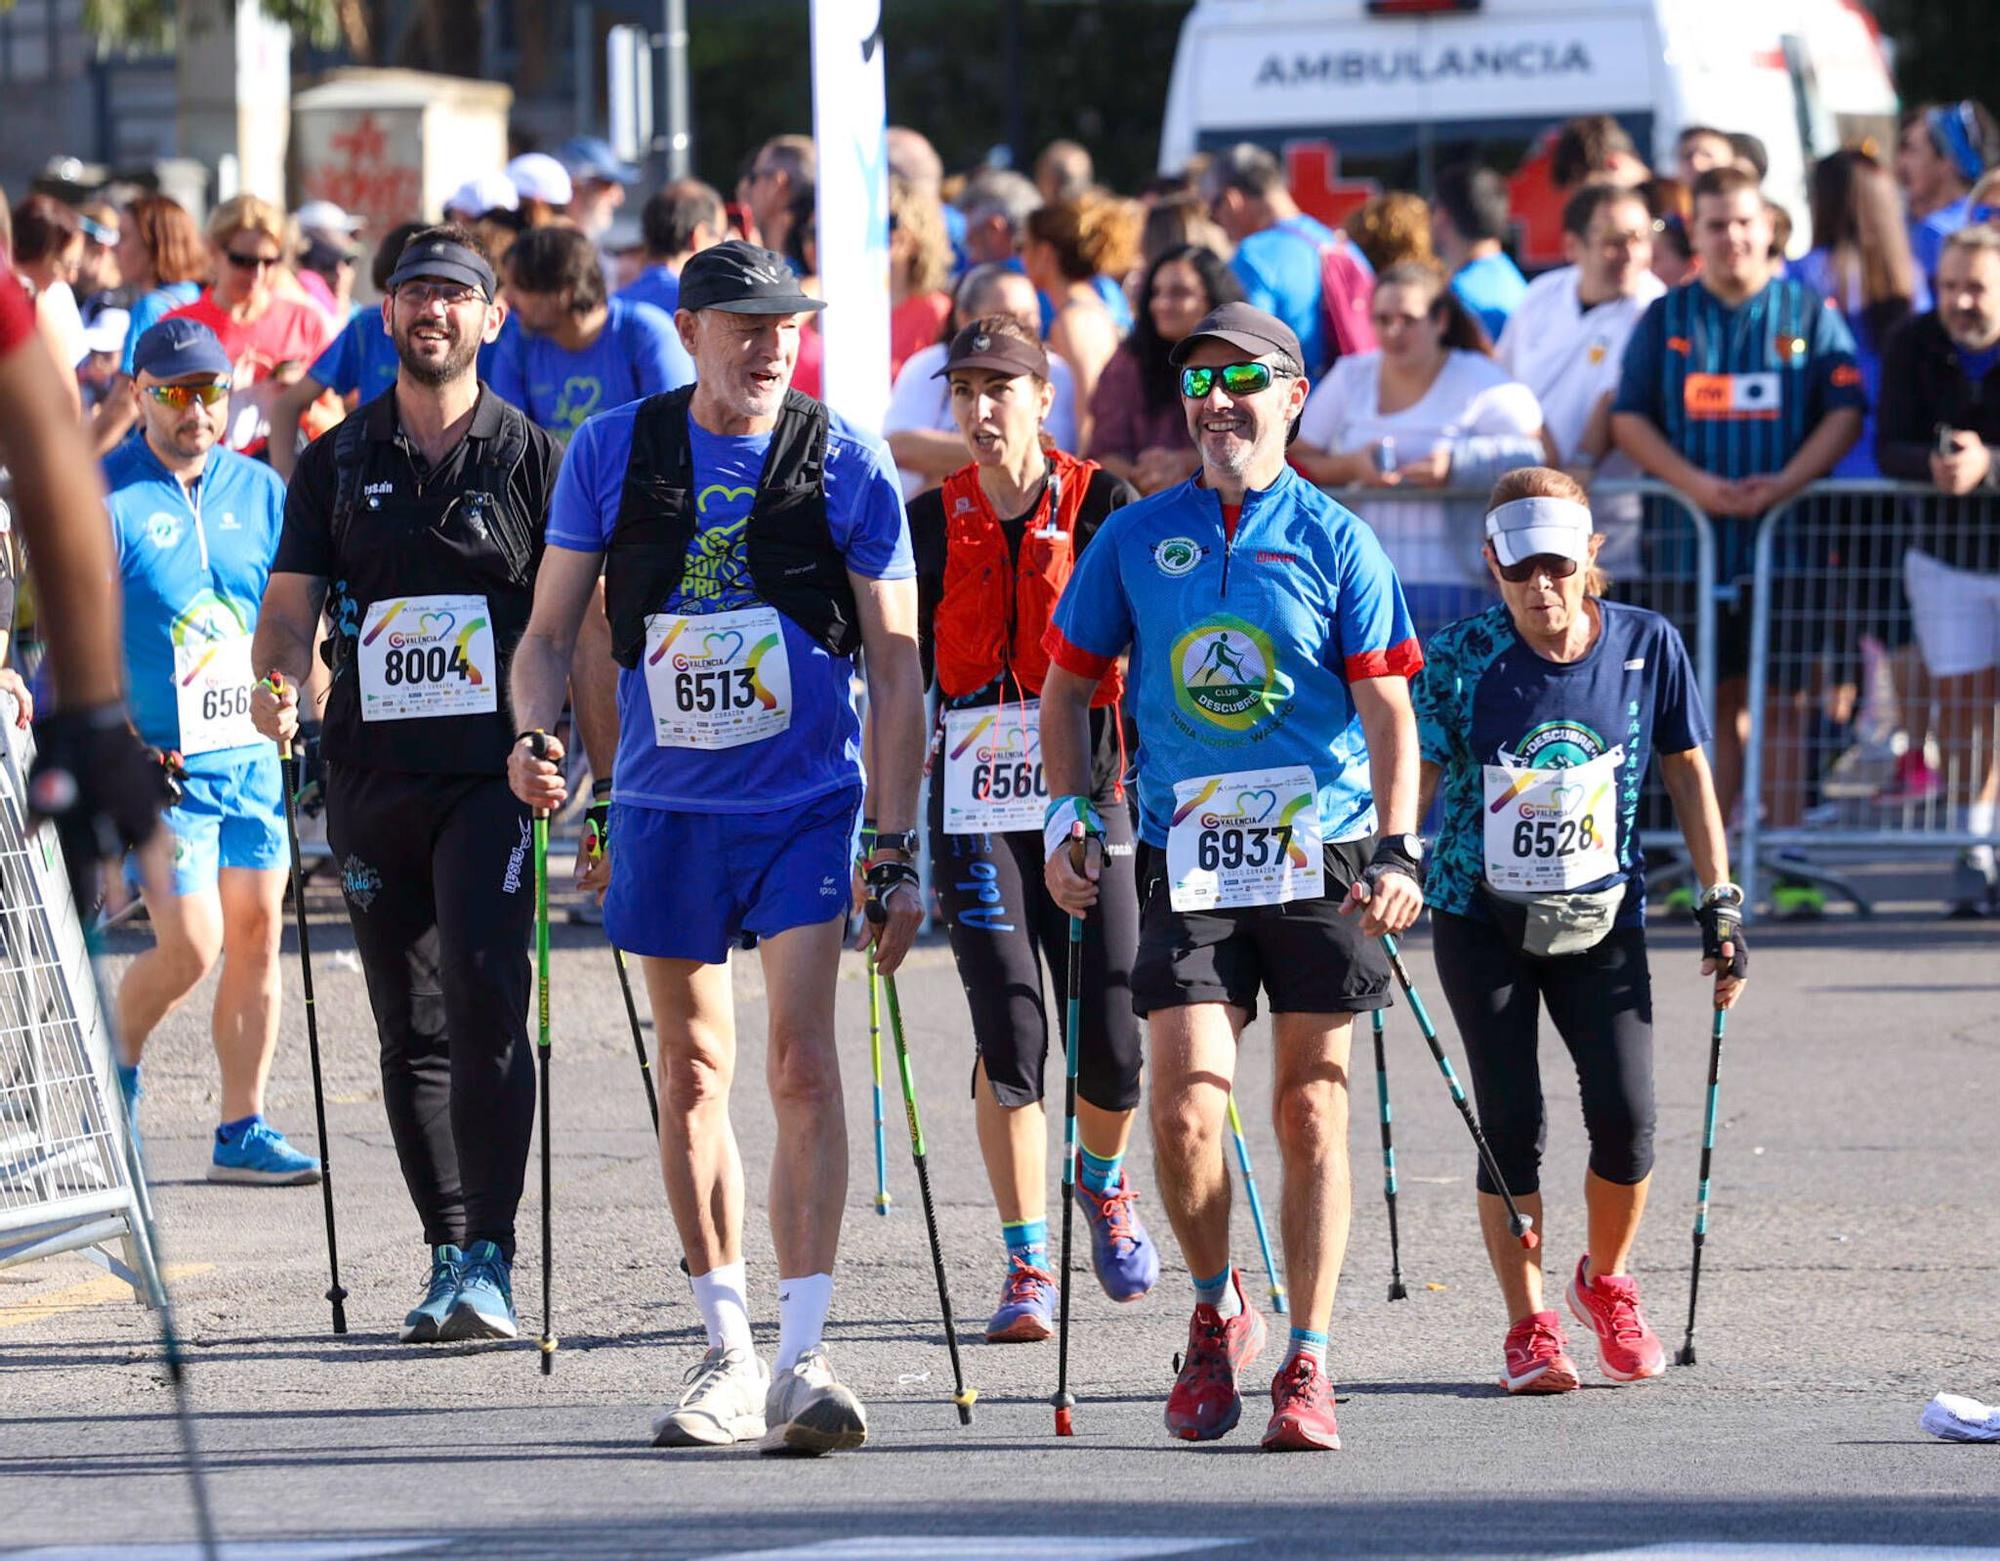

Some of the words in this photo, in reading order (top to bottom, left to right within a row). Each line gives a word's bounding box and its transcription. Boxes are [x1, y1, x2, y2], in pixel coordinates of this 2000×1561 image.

[1256, 40, 1593, 85] AMBULANCIA
[684, 553, 721, 577] SOY
[385, 645, 469, 686] 8004
[203, 685, 254, 720] 656
[675, 667, 756, 713] 6513
[1198, 692, 1259, 713] DESCUBRE
[1215, 688, 1240, 697] CLUB
[1170, 709, 1198, 740] TURIA
[1526, 729, 1595, 754] DESCUBRE
[1199, 825, 1293, 872] 6937
[1513, 813, 1594, 858] 6528
[955, 862, 1015, 932] Ado
